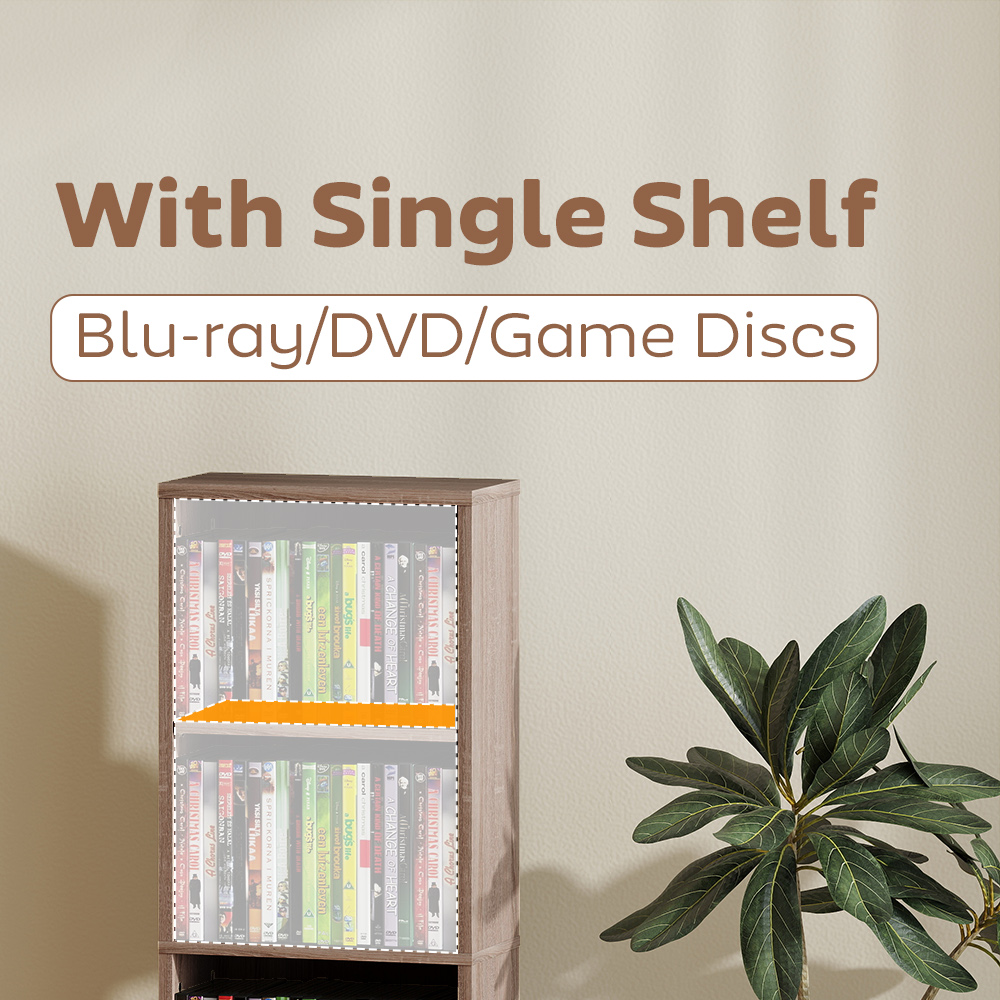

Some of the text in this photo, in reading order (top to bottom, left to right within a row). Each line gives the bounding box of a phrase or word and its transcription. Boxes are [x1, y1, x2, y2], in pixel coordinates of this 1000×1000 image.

[317, 606, 327, 628] een
[385, 585, 396, 636] CHANGE
[385, 654, 396, 694] HEART
[189, 790, 200, 841] CHRISTMAS
[385, 807, 396, 858] CHANGE
[317, 827, 327, 849] een
[385, 876, 396, 916] HEART
